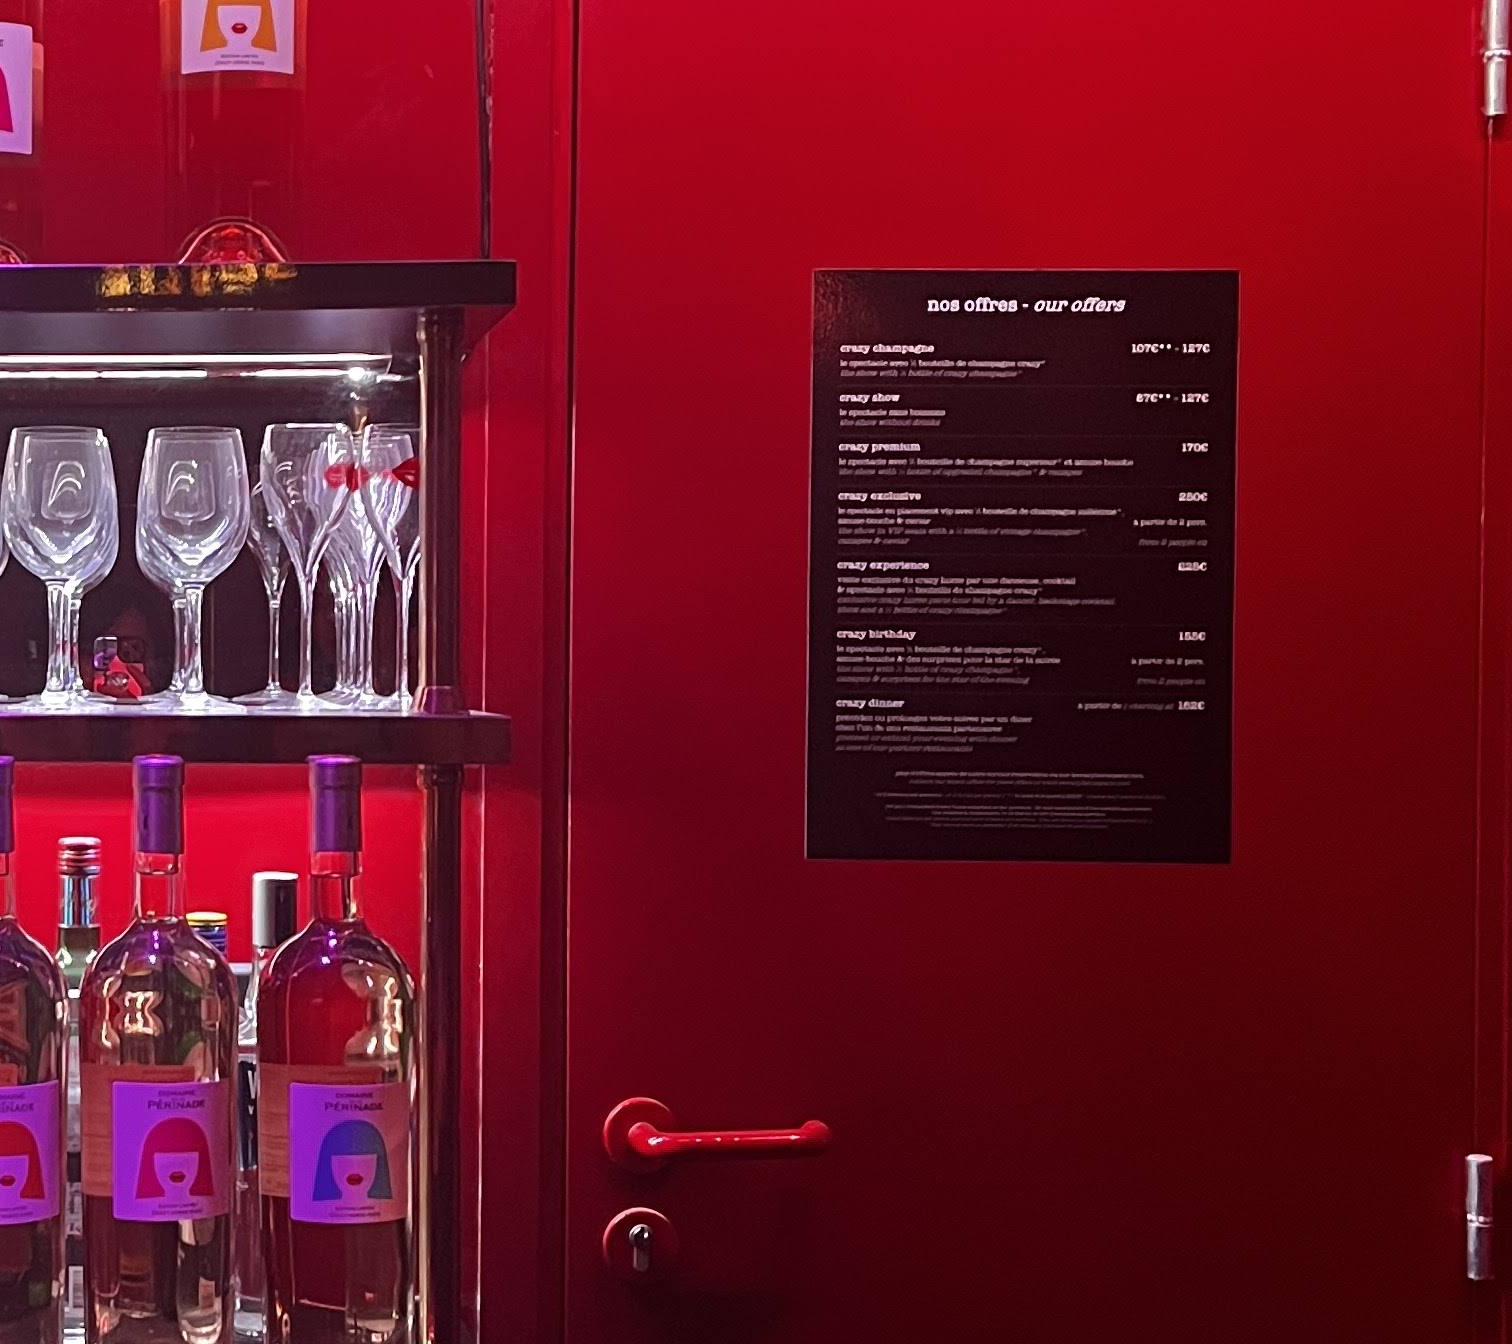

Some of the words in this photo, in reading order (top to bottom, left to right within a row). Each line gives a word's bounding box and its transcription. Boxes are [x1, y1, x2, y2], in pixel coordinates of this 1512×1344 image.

[928, 299, 960, 312] nos
[964, 297, 1018, 312] offres
[1034, 299, 1069, 312] our
[1071, 297, 1126, 312] offers
[840, 344, 870, 354] crazy
[873, 344, 935, 354] champagne
[839, 394, 870, 404] crazy
[872, 393, 901, 402] show
[839, 443, 869, 453] crazy
[872, 443, 921, 453] premium
[838, 493, 868, 501] crazy
[870, 492, 921, 501] exclusive
[837, 562, 867, 571] crazy
[869, 561, 929, 571] experience
[836, 630, 867, 640] crazy
[868, 629, 916, 641] birthday
[835, 699, 866, 709] crazy
[868, 699, 905, 708] dinner
